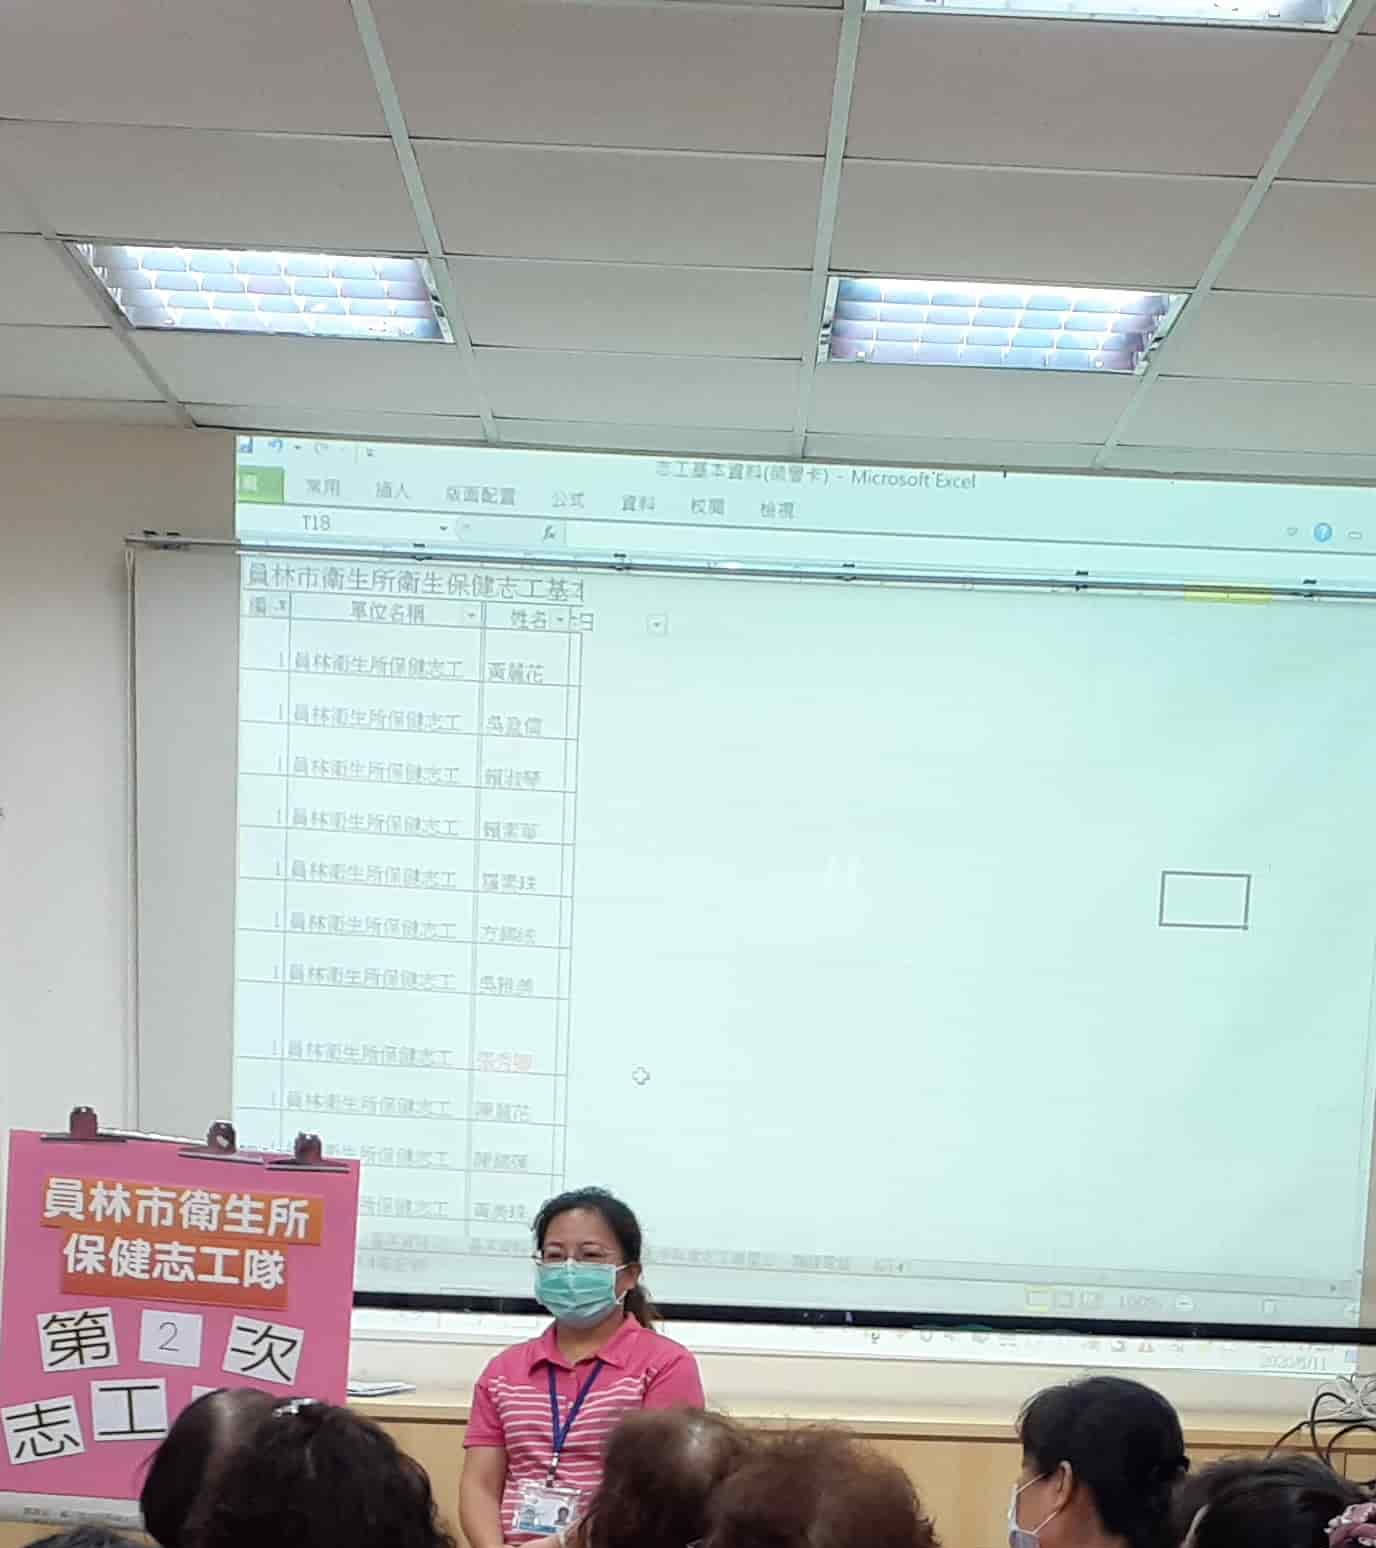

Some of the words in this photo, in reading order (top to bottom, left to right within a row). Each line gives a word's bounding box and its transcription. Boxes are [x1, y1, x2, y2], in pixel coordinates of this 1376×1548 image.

[851, 469, 931, 487] Microsoft
[935, 472, 976, 489] Excel
[44, 1177, 310, 1240] 員林市衛生所
[62, 1233, 285, 1290] 保健志工隊
[4, 1385, 167, 1459] 志工
